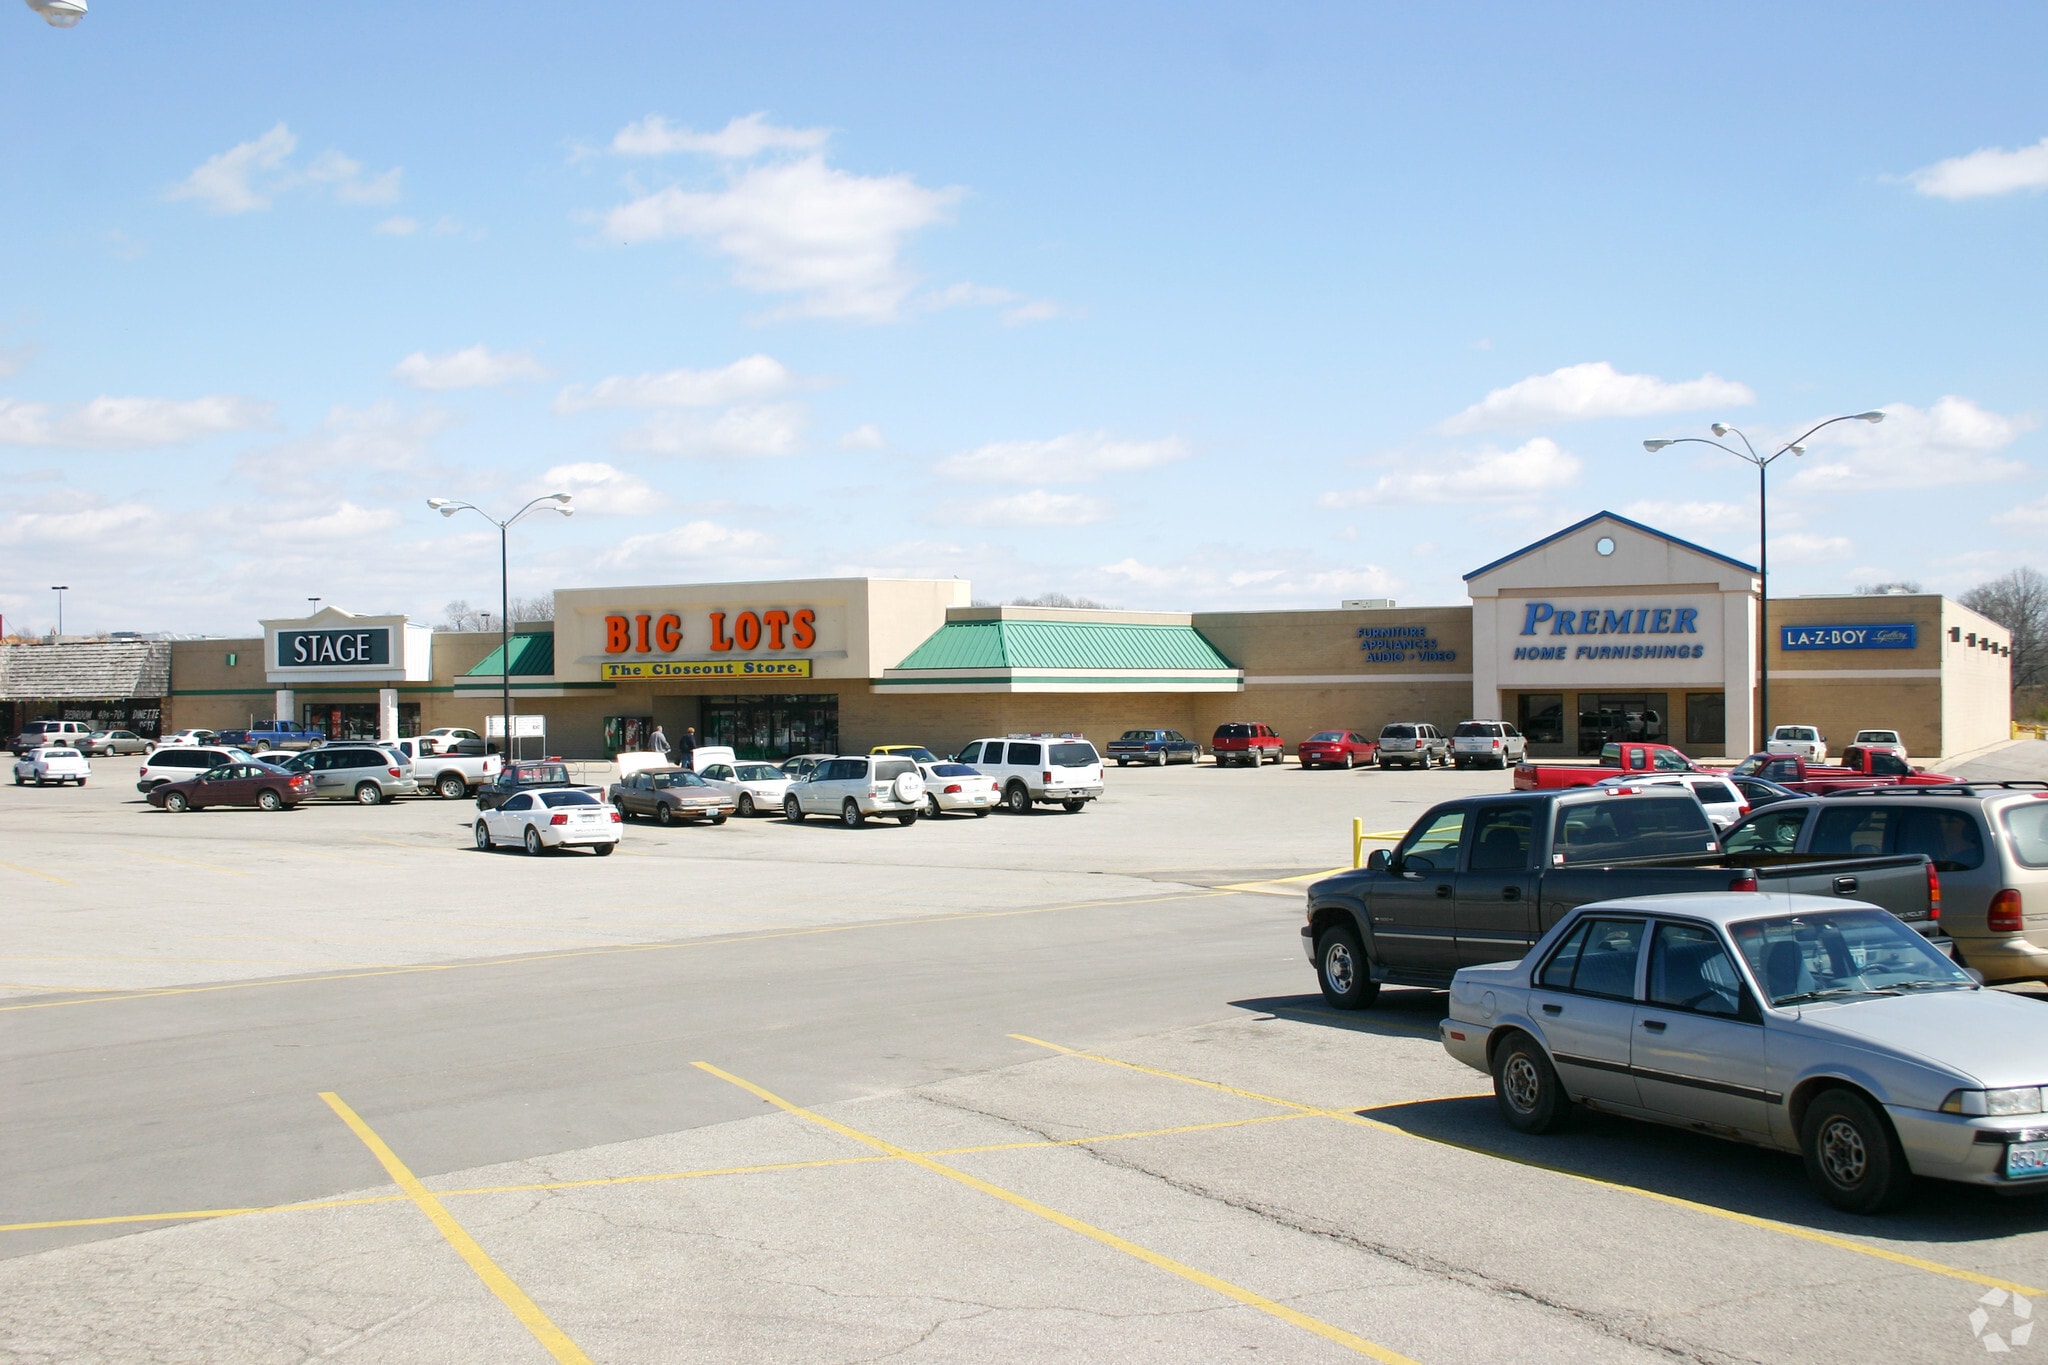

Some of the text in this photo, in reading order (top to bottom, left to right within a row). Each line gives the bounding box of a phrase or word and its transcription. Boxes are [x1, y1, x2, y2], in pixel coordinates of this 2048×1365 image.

[1519, 603, 1698, 635] PREMIER
[605, 609, 815, 653] BIG LOTS
[1357, 627, 1425, 638] FURNITURE
[1787, 630, 1867, 645] LA-Z-BOY
[294, 634, 370, 663] STAGE
[1361, 639, 1437, 650] APPLIANCES
[1514, 644, 1704, 660] HOME FURNISHINGS
[1366, 650, 1456, 662] AUDIO VIDEO
[609, 662, 802, 675] The Closeout Store.
